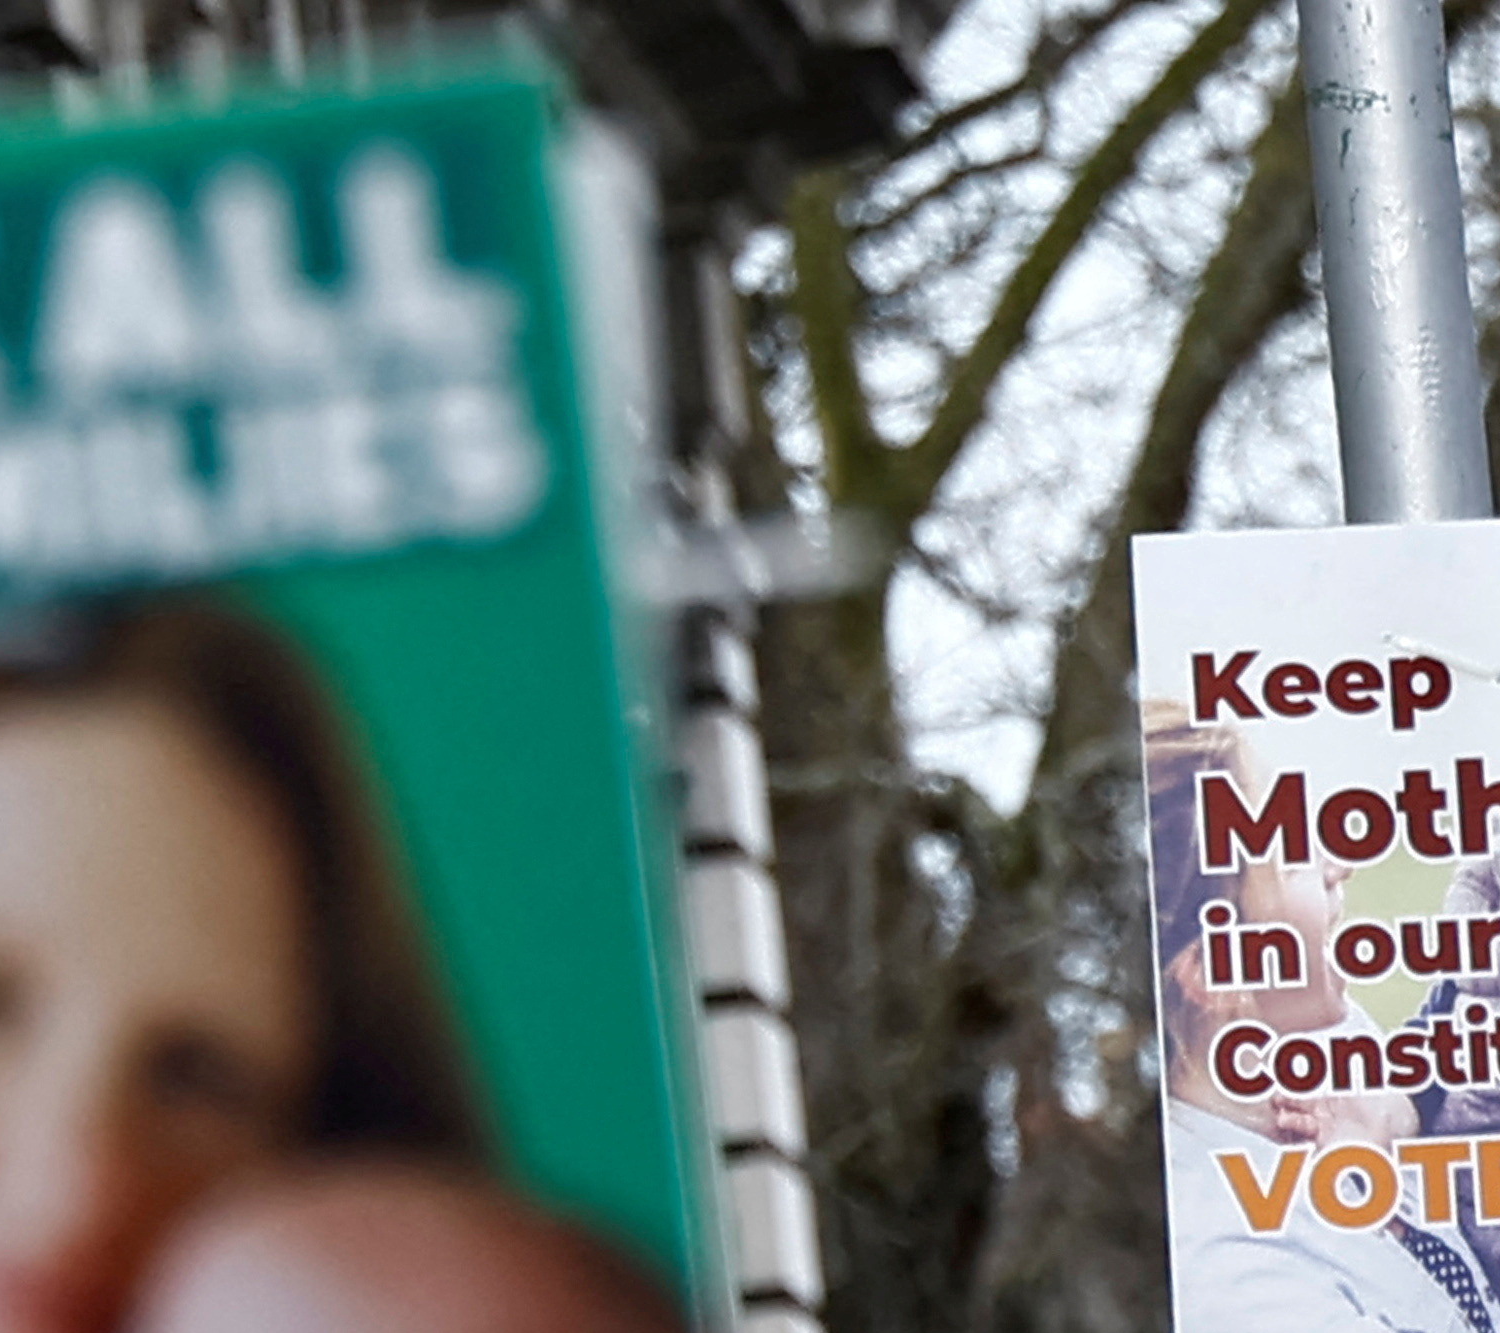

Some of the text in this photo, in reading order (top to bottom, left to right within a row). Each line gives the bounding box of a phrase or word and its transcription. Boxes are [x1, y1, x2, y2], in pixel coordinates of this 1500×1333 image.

[38, 148, 518, 378] ALL
[1192, 653, 1451, 731] Keep
[1207, 905, 1302, 985] in
